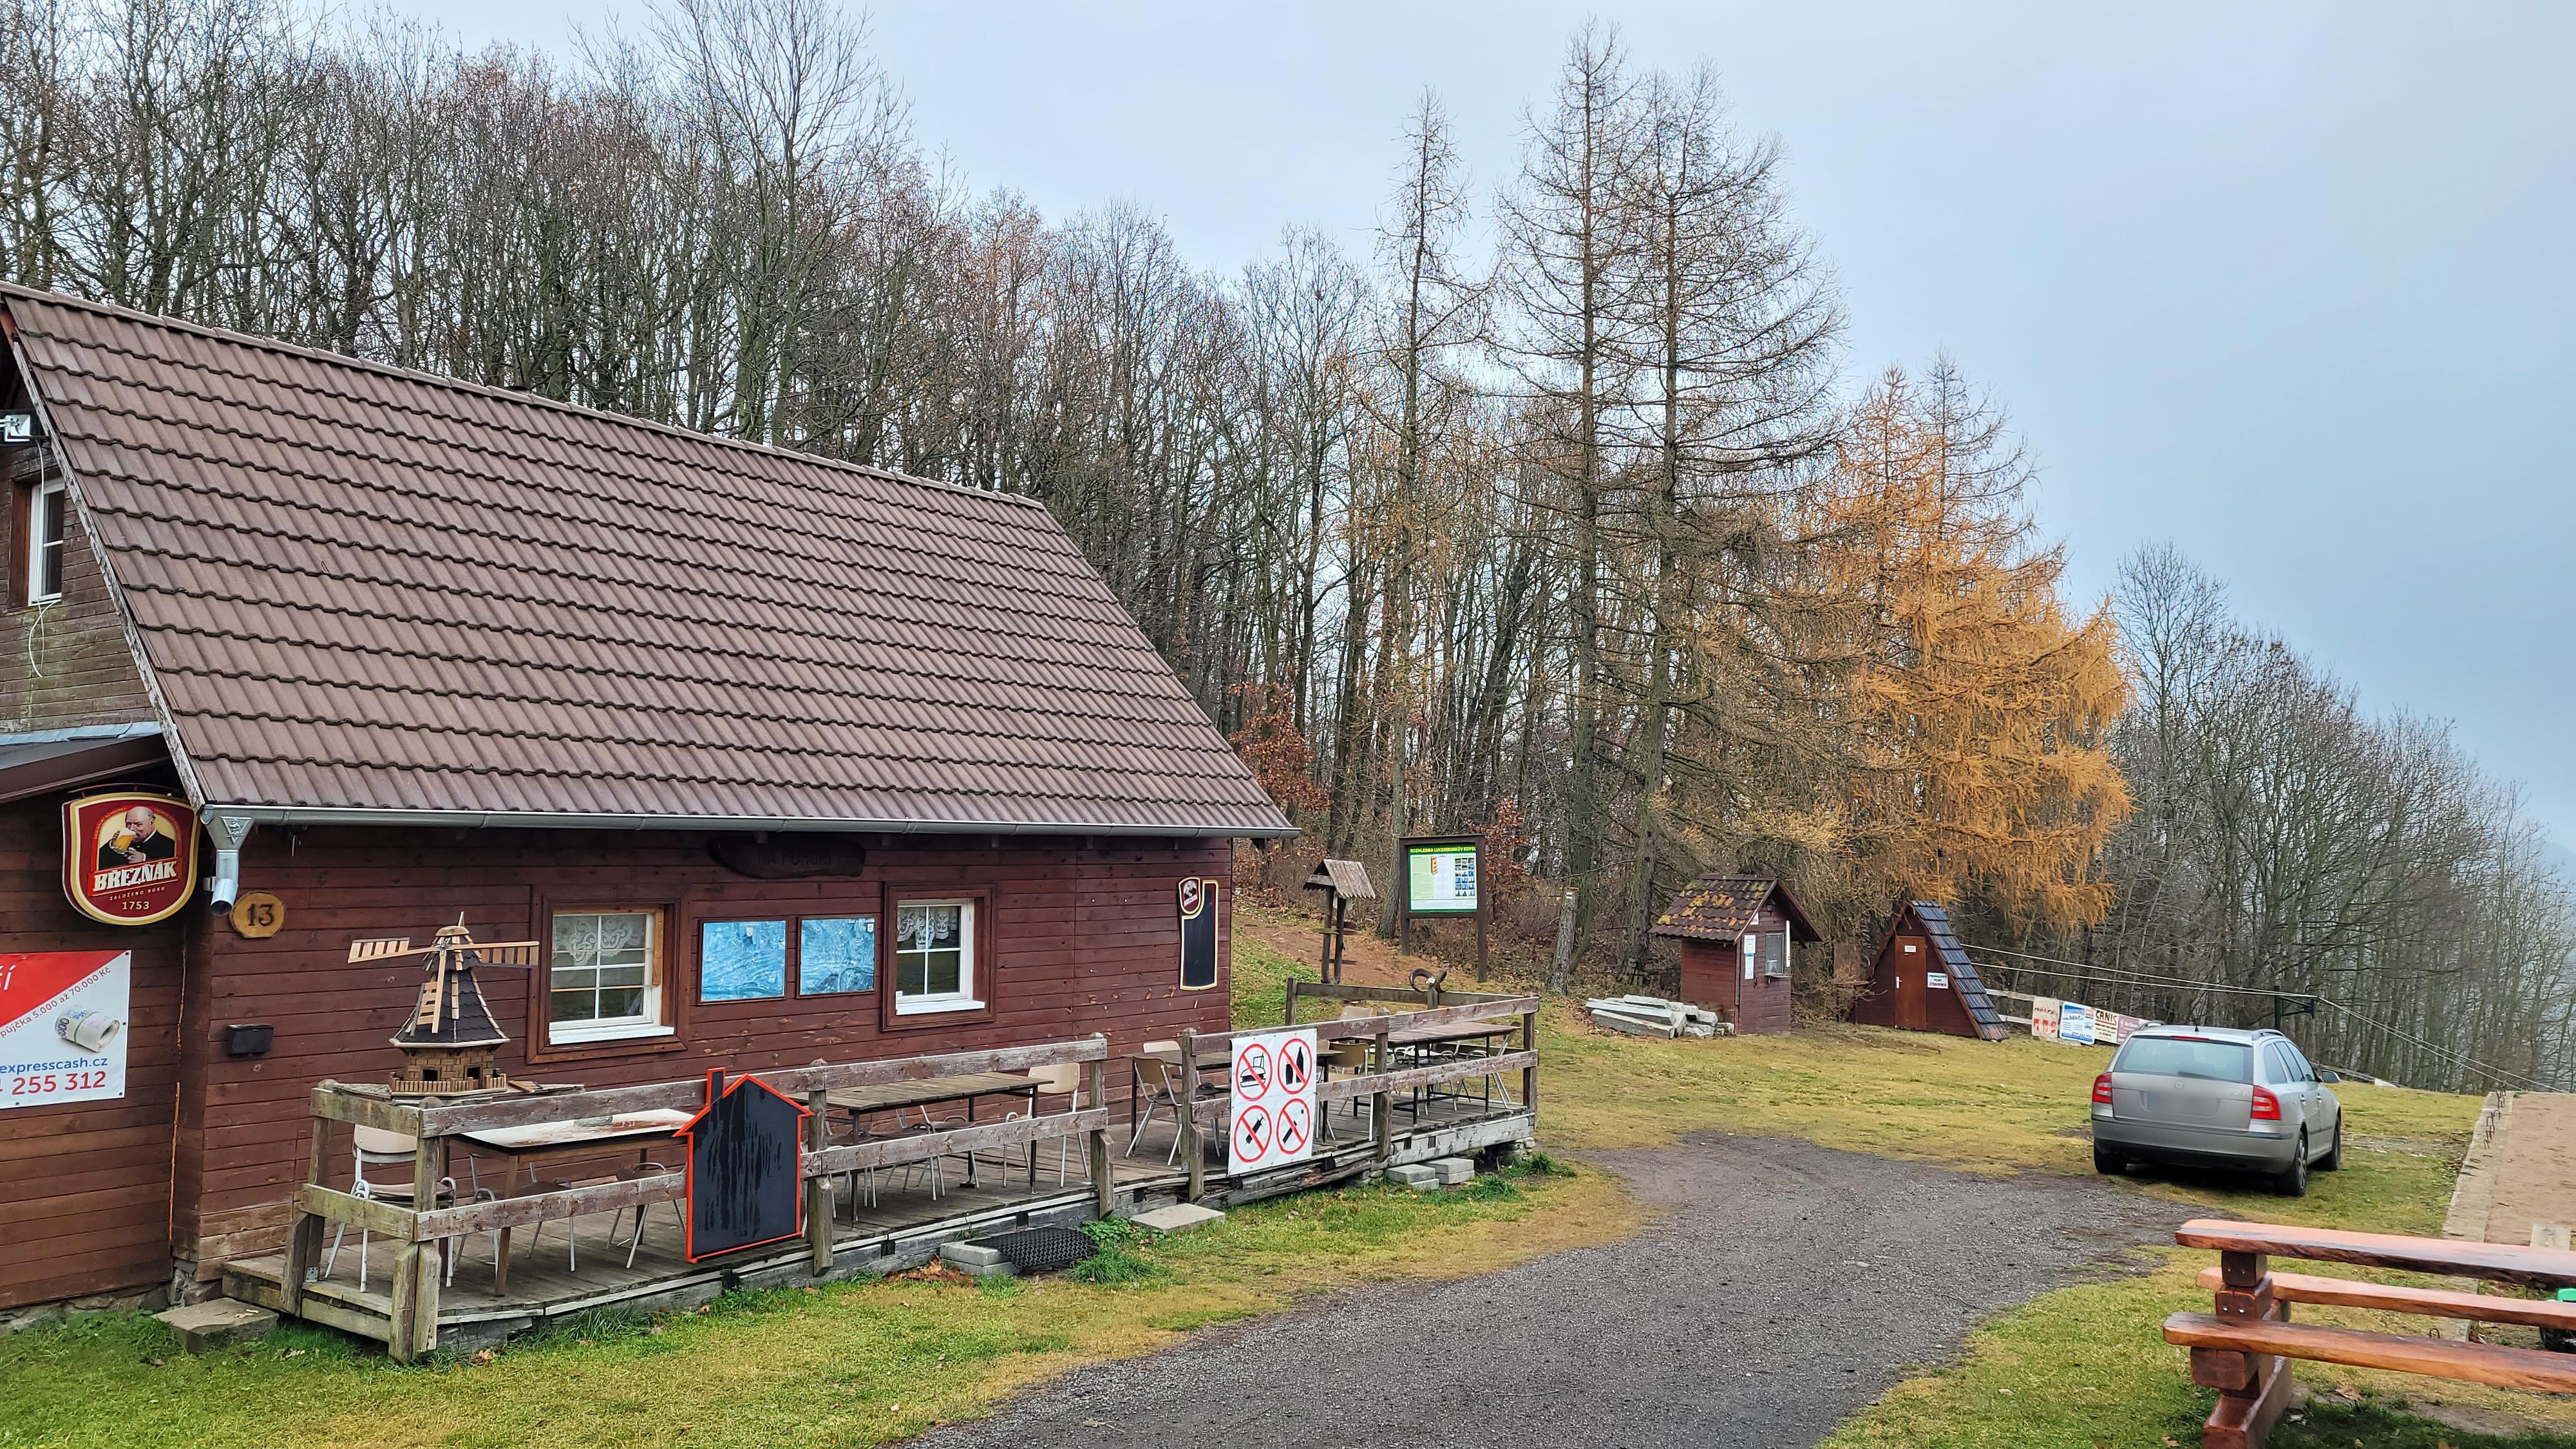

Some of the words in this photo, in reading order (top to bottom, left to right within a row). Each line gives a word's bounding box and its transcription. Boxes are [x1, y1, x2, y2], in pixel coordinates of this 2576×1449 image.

[93, 860, 177, 892] BŘEZŇÁK
[109, 890, 144, 901] ZALOŽENO
[122, 901, 149, 910] 1753
[247, 903, 274, 926] 13
[0, 1017, 32, 1038] půjčka
[32, 1000, 57, 1019] 5.000
[59, 993, 70, 1003] až
[69, 974, 99, 996] 70.000
[99, 967, 111, 977] Kč
[2096, 1009, 2117, 1025] CANIS
[12, 1075, 57, 1095] 255
[64, 1071, 106, 1091] 312
